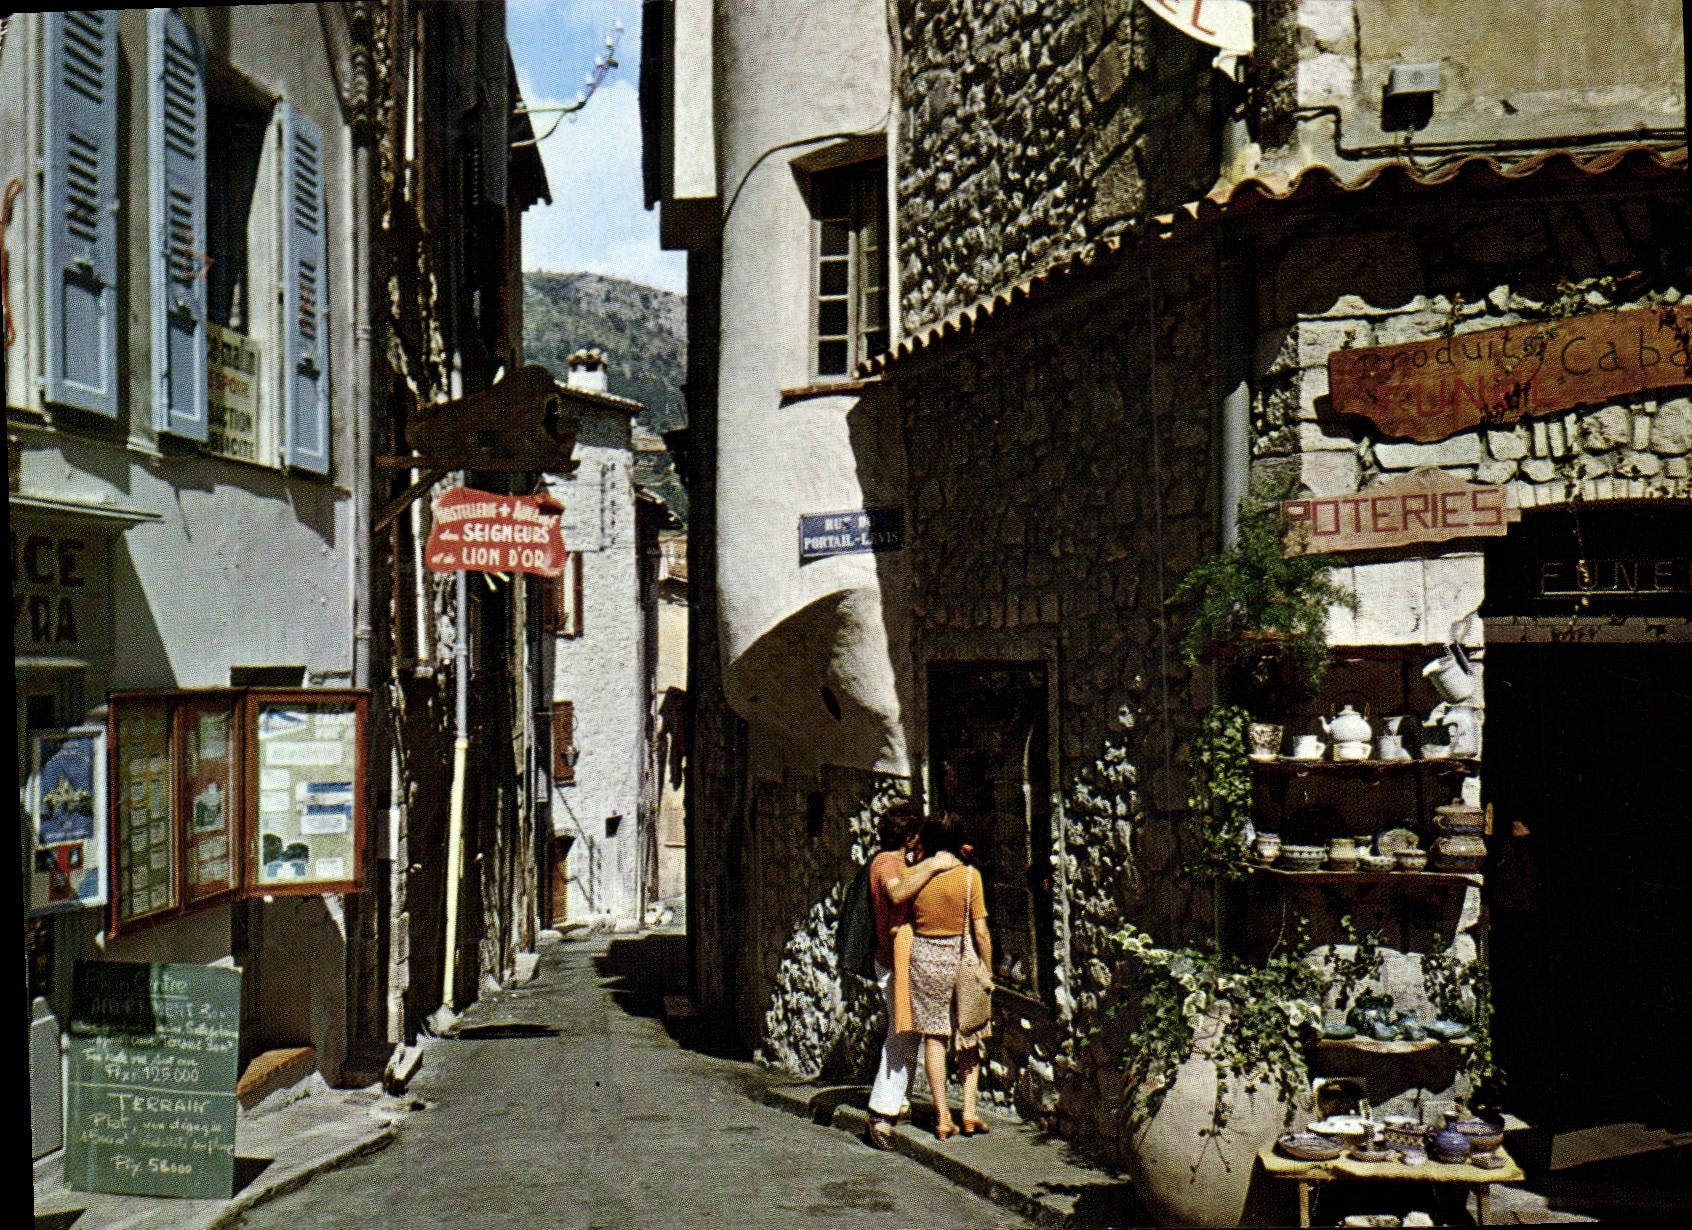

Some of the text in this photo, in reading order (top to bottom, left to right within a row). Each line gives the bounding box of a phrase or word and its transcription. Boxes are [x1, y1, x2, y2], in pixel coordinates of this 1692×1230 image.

[1279, 488, 1504, 535] POTERIES
[462, 522, 550, 544] SEIGNEURS
[804, 531, 899, 550] PORTAIL-LVIS
[11, 534, 85, 587] CE
[462, 546, 500, 566] LION
[508, 546, 544, 568] D'OR
[107, 1093, 211, 1114] TERRAIN
